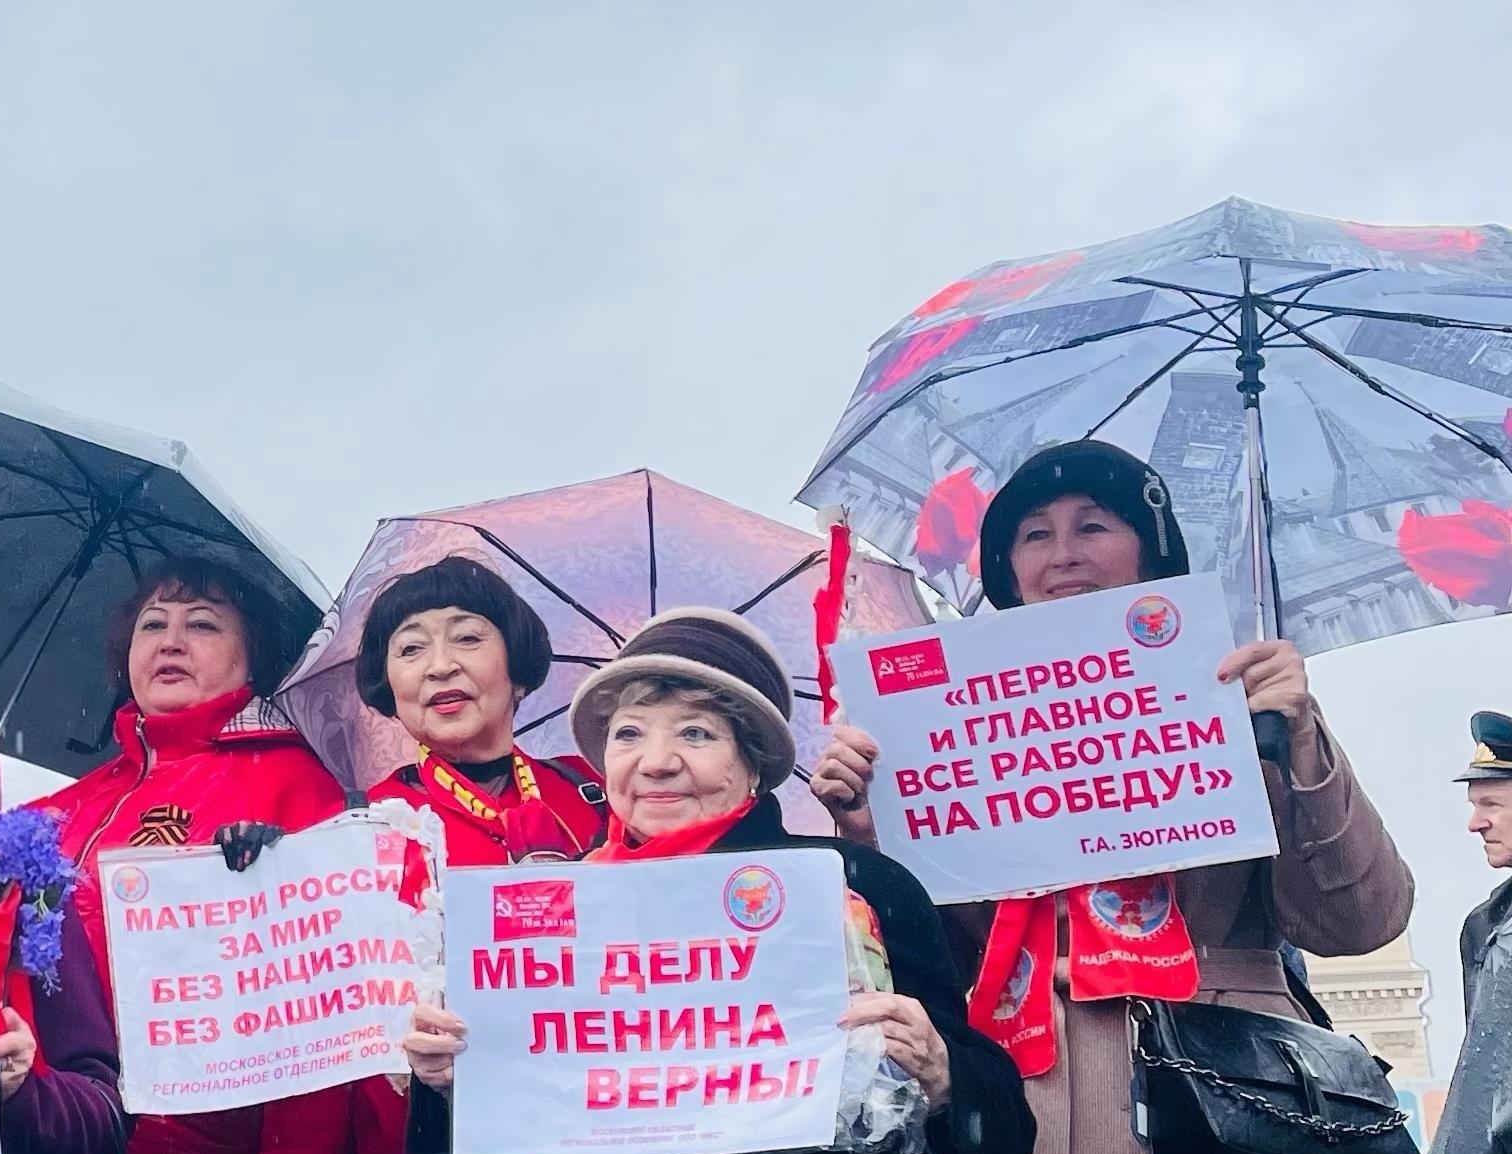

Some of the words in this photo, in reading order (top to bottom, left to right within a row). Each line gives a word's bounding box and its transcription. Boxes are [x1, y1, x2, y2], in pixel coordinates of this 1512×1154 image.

[944, 649, 1135, 707] «ПЕРВОЕ
[965, 686, 1162, 747] ГЛАВНОЕ
[896, 759, 979, 798] ВСЕ
[991, 717, 1225, 781] РАБОТАЕМ
[905, 803, 980, 841] НА
[986, 761, 1233, 829] ПОБЕДУ!»
[1080, 837, 1116, 854] Г.А.
[1122, 819, 1236, 850] ЗЮГАНОВ
[126, 892, 267, 932] МАТЕРИ
[280, 868, 399, 910] РОССИ
[219, 932, 263, 960] ЗА
[271, 908, 342, 948] МИР
[1080, 949, 1140, 965] НАДЕЖДА
[152, 974, 224, 1003] БЕЗ
[238, 939, 414, 995] НАЦИЗМА
[472, 946, 576, 990] МЫ
[600, 936, 760, 995] ДЕЛУ
[148, 1016, 221, 1046] БЕЗ
[234, 980, 418, 1037] ФАШИЗМА
[529, 1004, 788, 1054] ЛЕНИНА
[152, 1071, 270, 1096] РЕГИОНАЛЬНОЕ
[274, 1051, 353, 1081] ОТДЕЛЕНИЕ
[360, 1042, 391, 1059] ООО
[206, 1045, 300, 1074] МОСКОВСКОЕ
[305, 1025, 385, 1056] ОБЛАСТНОЕ
[586, 1058, 820, 1110] ВЕРНЫ!
